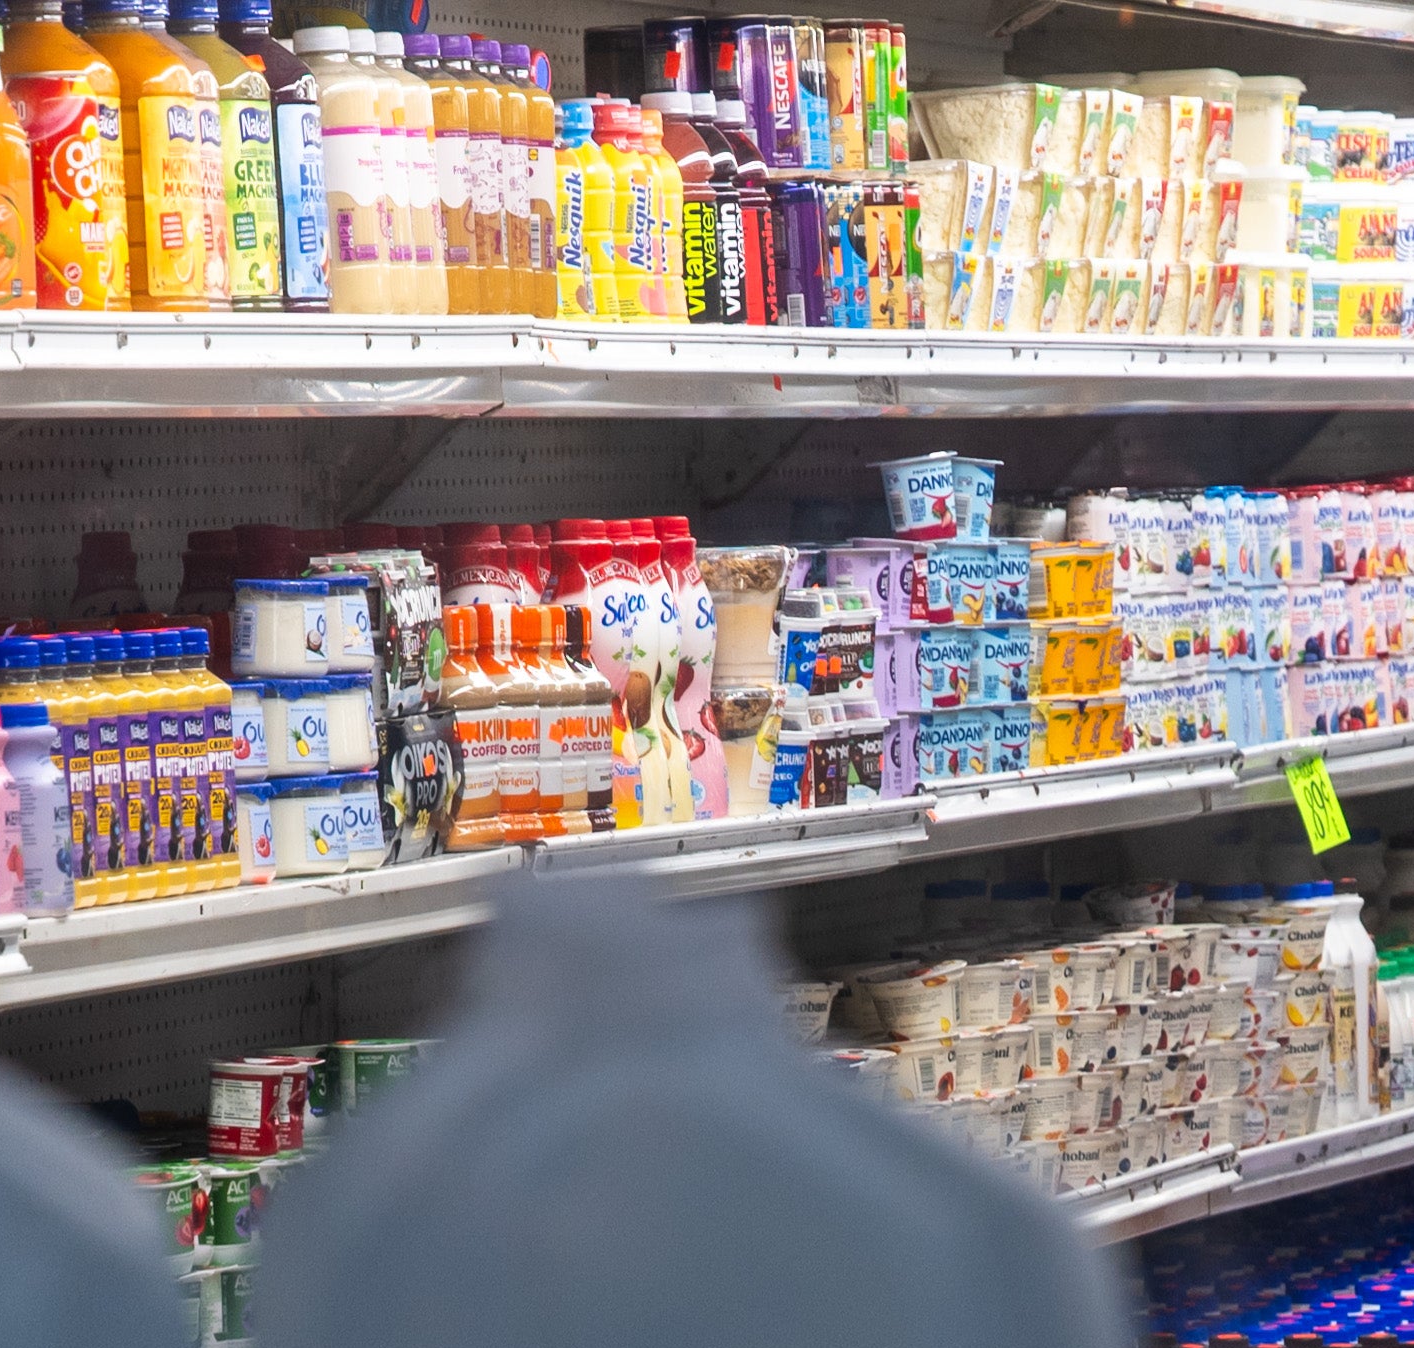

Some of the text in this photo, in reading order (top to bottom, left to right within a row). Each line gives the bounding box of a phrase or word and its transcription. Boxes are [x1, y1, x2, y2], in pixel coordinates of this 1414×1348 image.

[241, 111, 271, 139] Naked
[562, 171, 583, 269] Nesquik
[629, 176, 656, 267] Nesqui
[684, 202, 717, 316] vitamin water
[716, 202, 742, 316] vitamin
[417, 782, 437, 807] PRO
[500, 776, 534, 790] original
